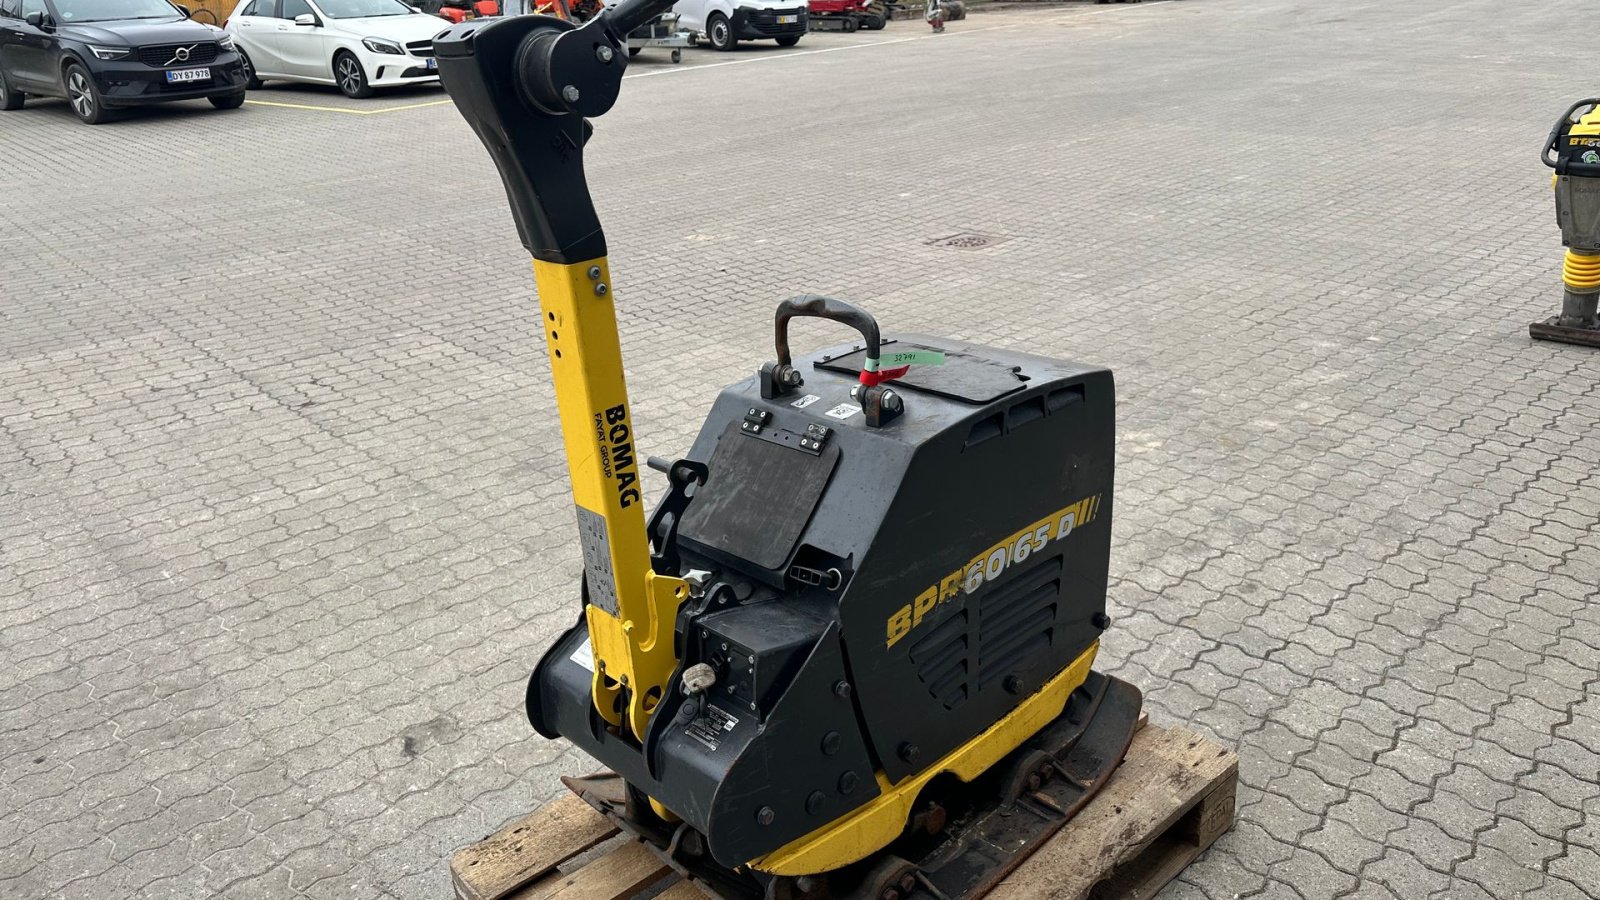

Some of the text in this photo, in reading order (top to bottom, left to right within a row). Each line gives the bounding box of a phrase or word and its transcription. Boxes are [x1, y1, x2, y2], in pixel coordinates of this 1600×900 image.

[172, 70, 210, 80] DY 87 978
[894, 353, 916, 362] 32791
[594, 412, 612, 479] FAYAT GROUP
[605, 403, 639, 509] BOMAG
[1055, 512, 1075, 541] D
